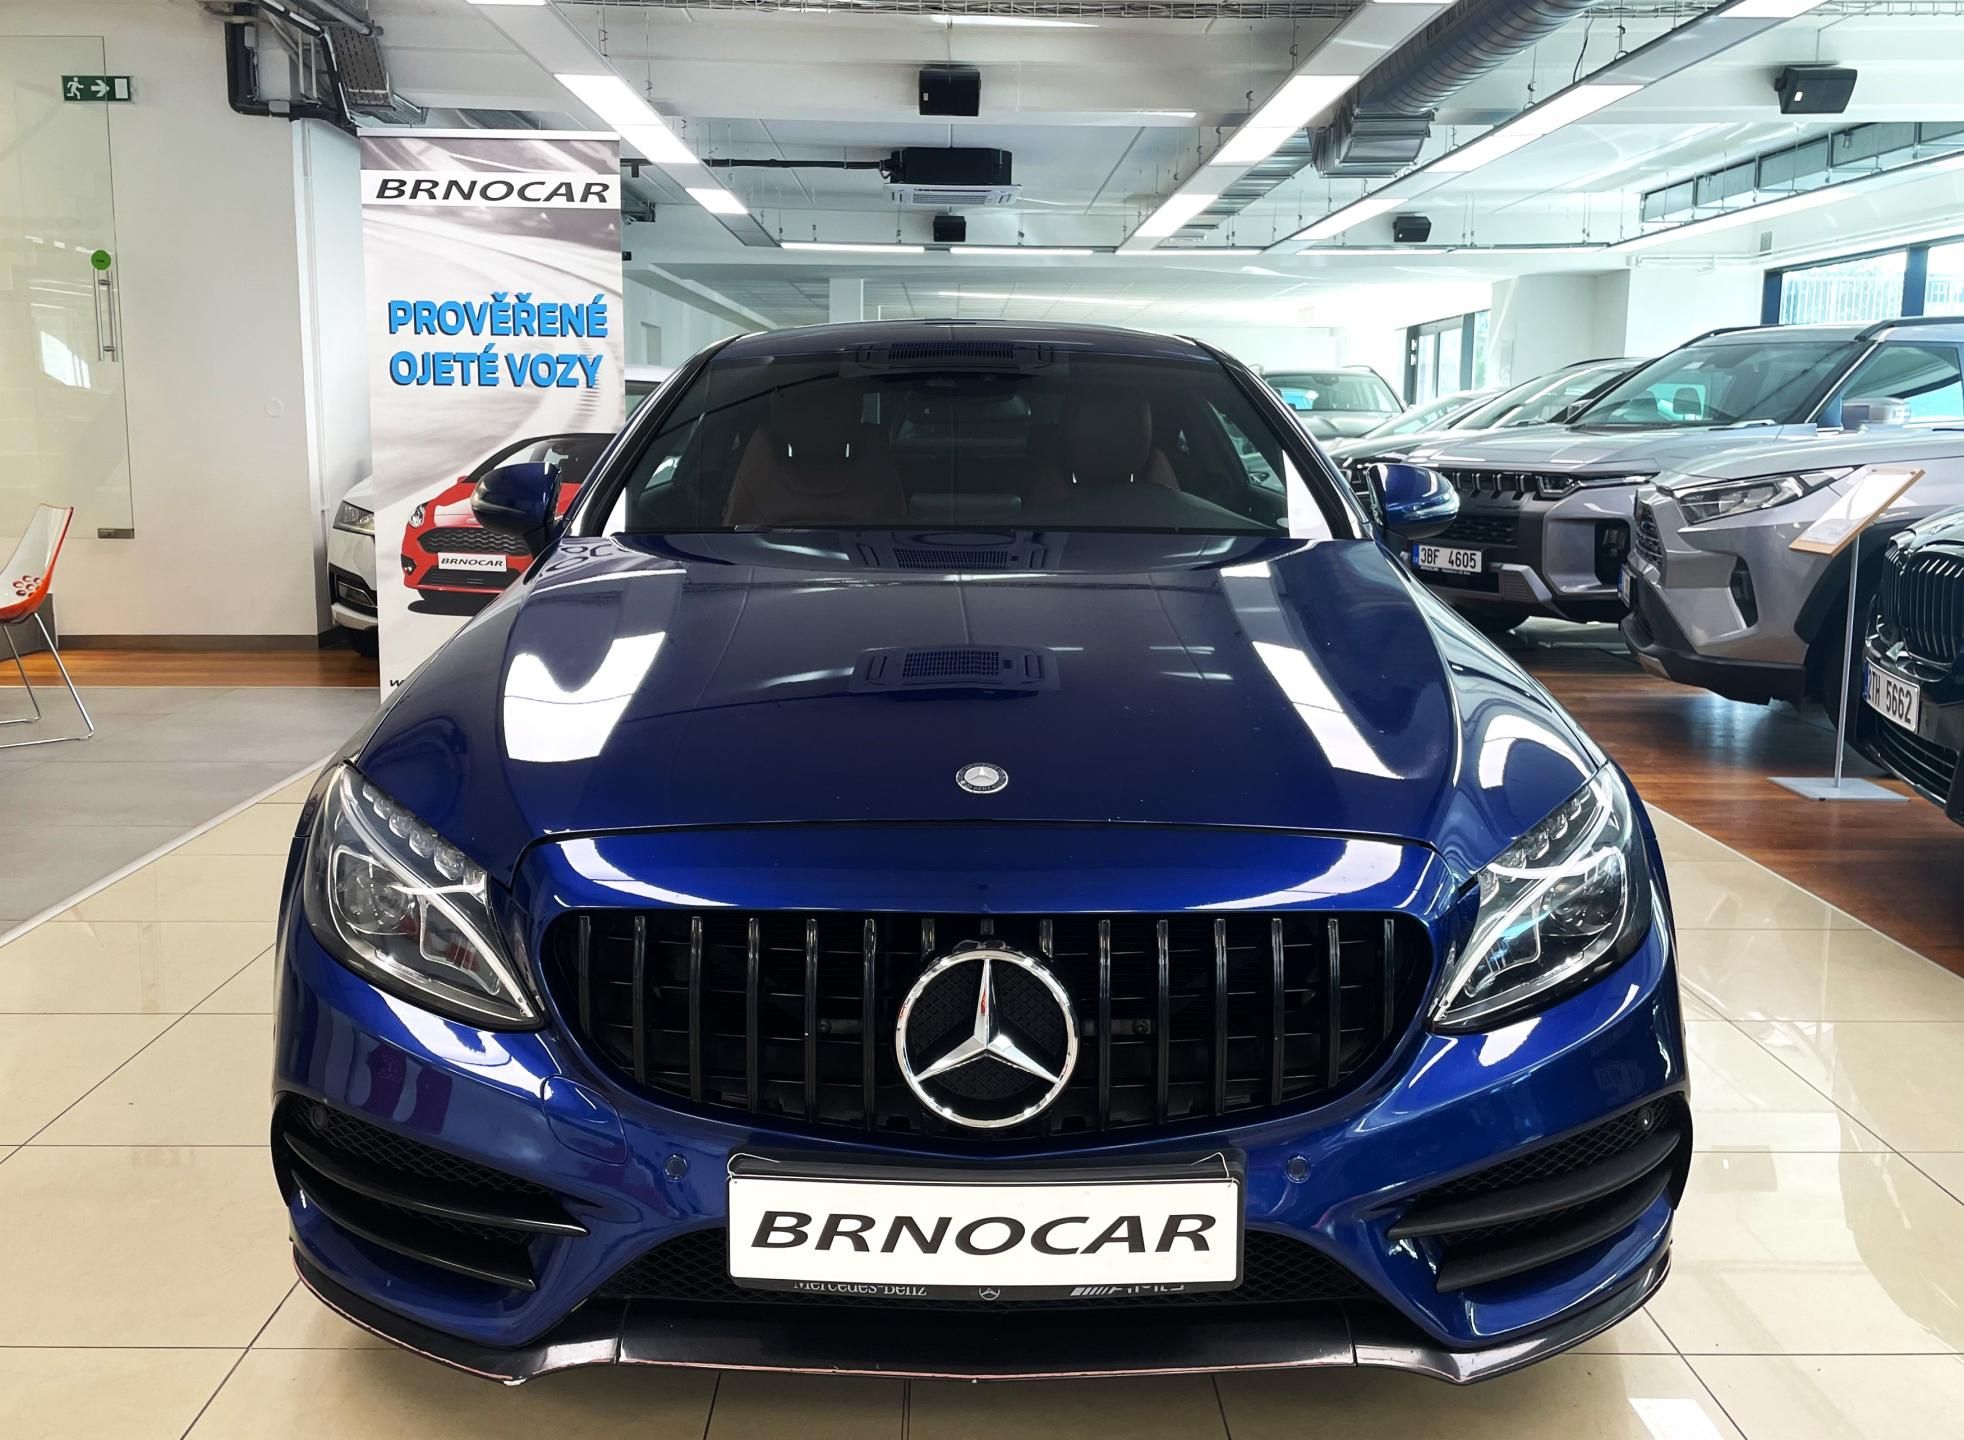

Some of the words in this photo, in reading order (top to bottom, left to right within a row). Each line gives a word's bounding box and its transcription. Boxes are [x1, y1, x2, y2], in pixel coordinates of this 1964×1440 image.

[376, 178, 611, 203] BRNOCAR
[388, 292, 608, 337] PROVĚŘENÉ
[389, 343, 500, 387] OJETÉ
[504, 352, 604, 389] VOZY
[441, 557, 504, 567] BRNOCAR
[1420, 547, 1440, 565] 3BF
[1448, 550, 1477, 569] 4605
[1886, 679, 1912, 725] 5662
[750, 1210, 1217, 1256] BRNOCAR
